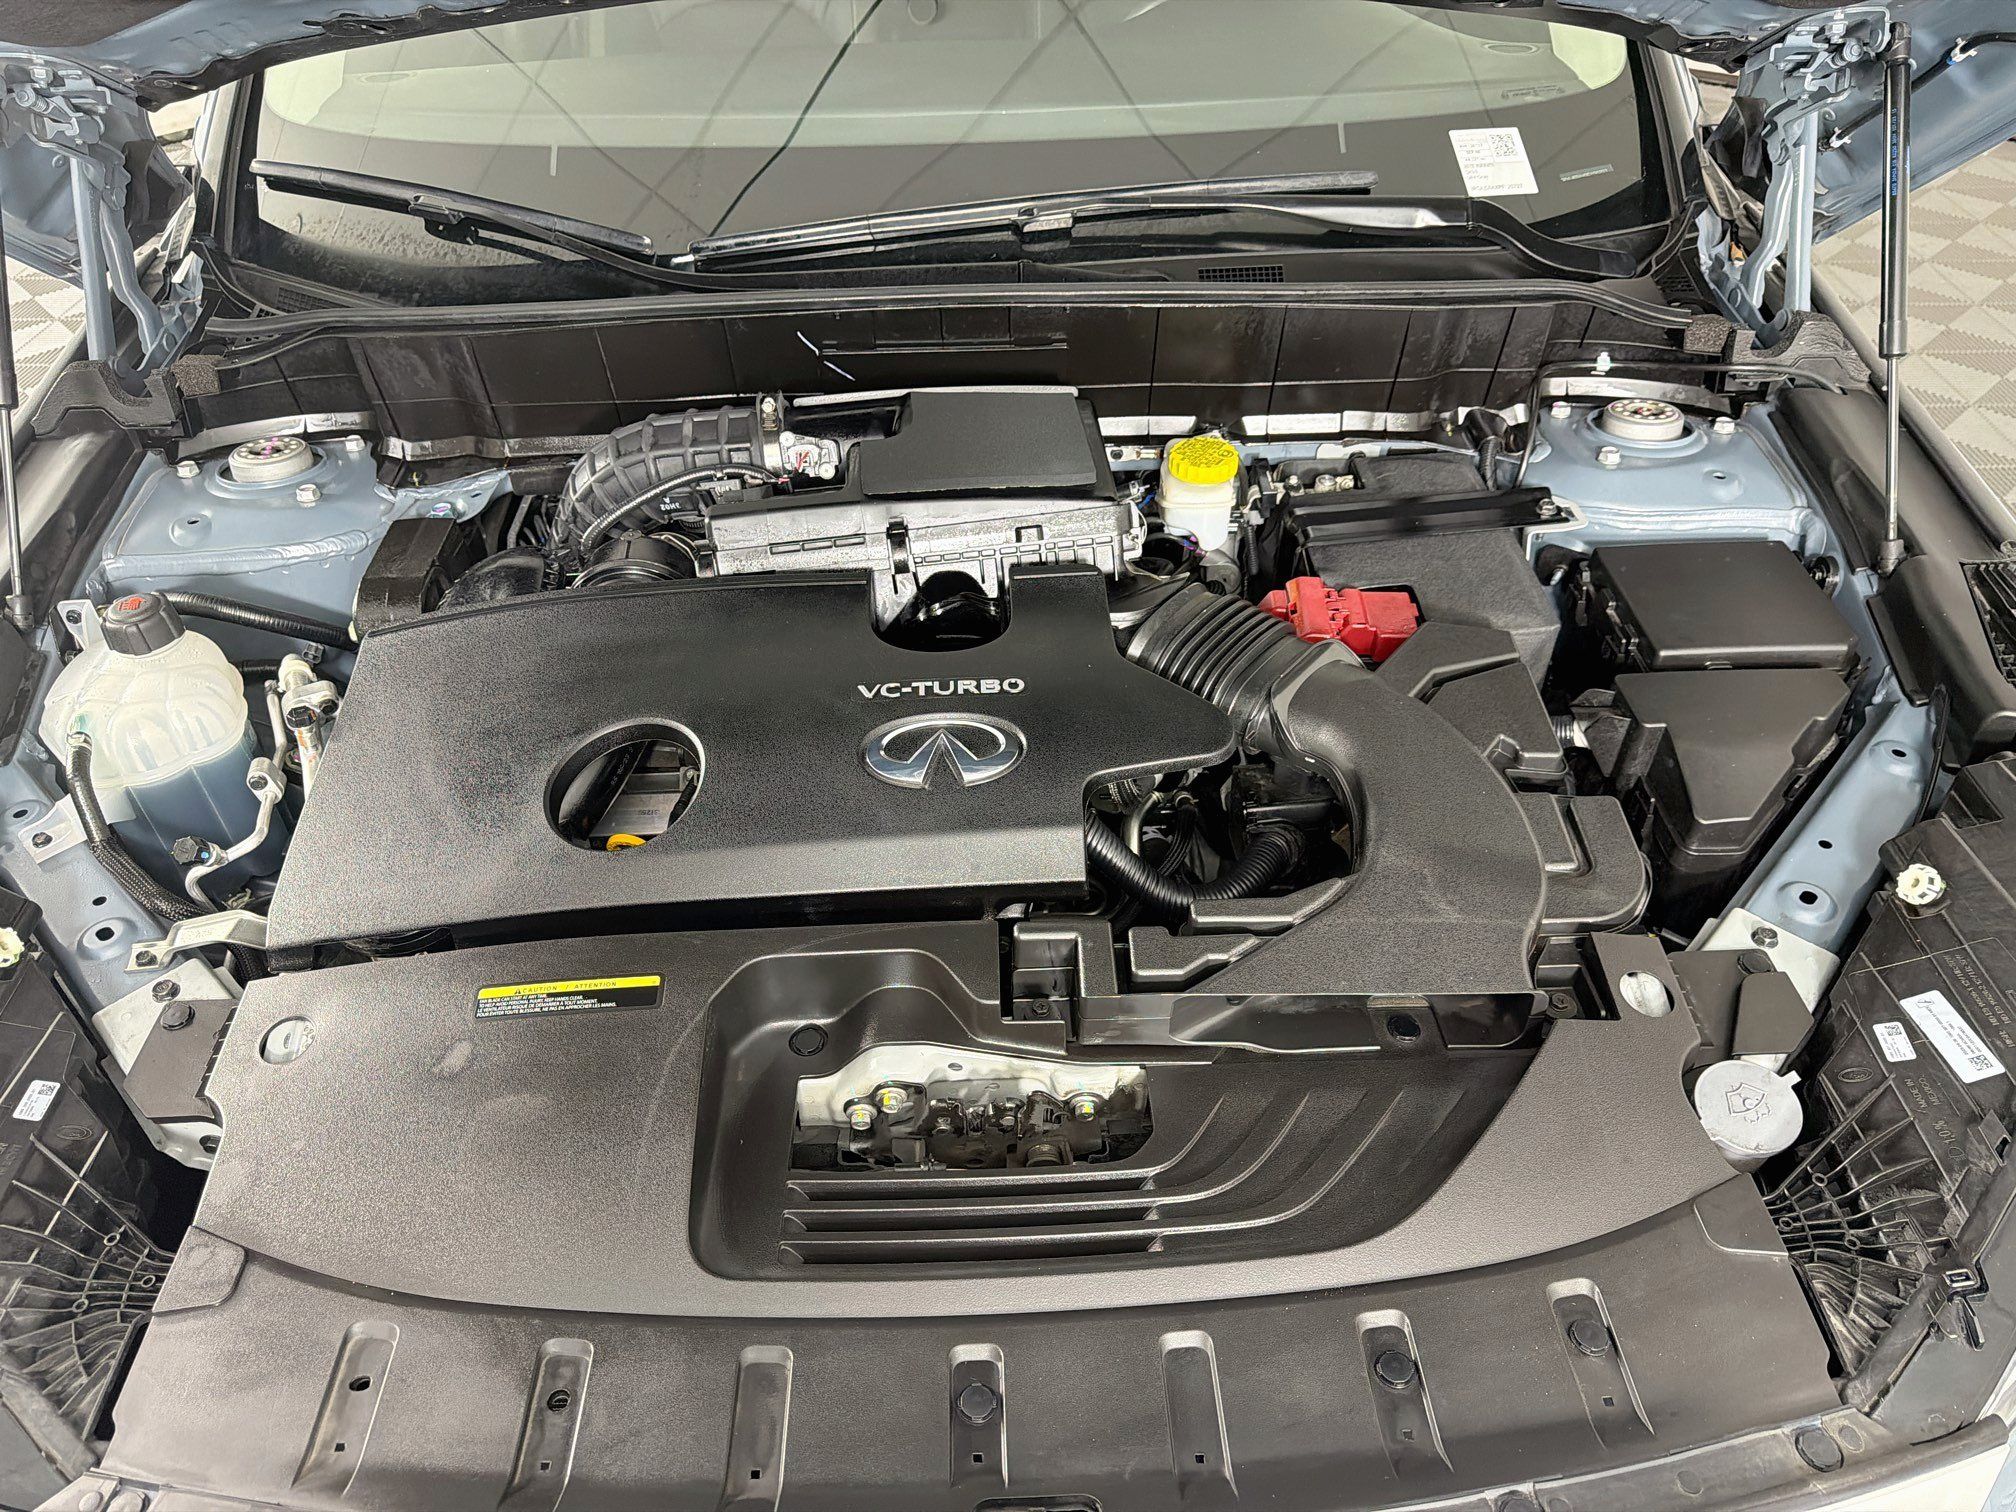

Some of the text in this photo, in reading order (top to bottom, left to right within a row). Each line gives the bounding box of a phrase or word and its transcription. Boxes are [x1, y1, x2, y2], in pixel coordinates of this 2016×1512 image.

[857, 677, 1025, 699] VC-TURBO
[522, 985, 557, 994] CAUTION
[574, 981, 617, 990] ATTENTION
[483, 1004, 511, 1012] VENTILATEUR
[565, 1002, 592, 1010] APPROCHER
[1904, 1078, 1928, 1108] MADE IN
